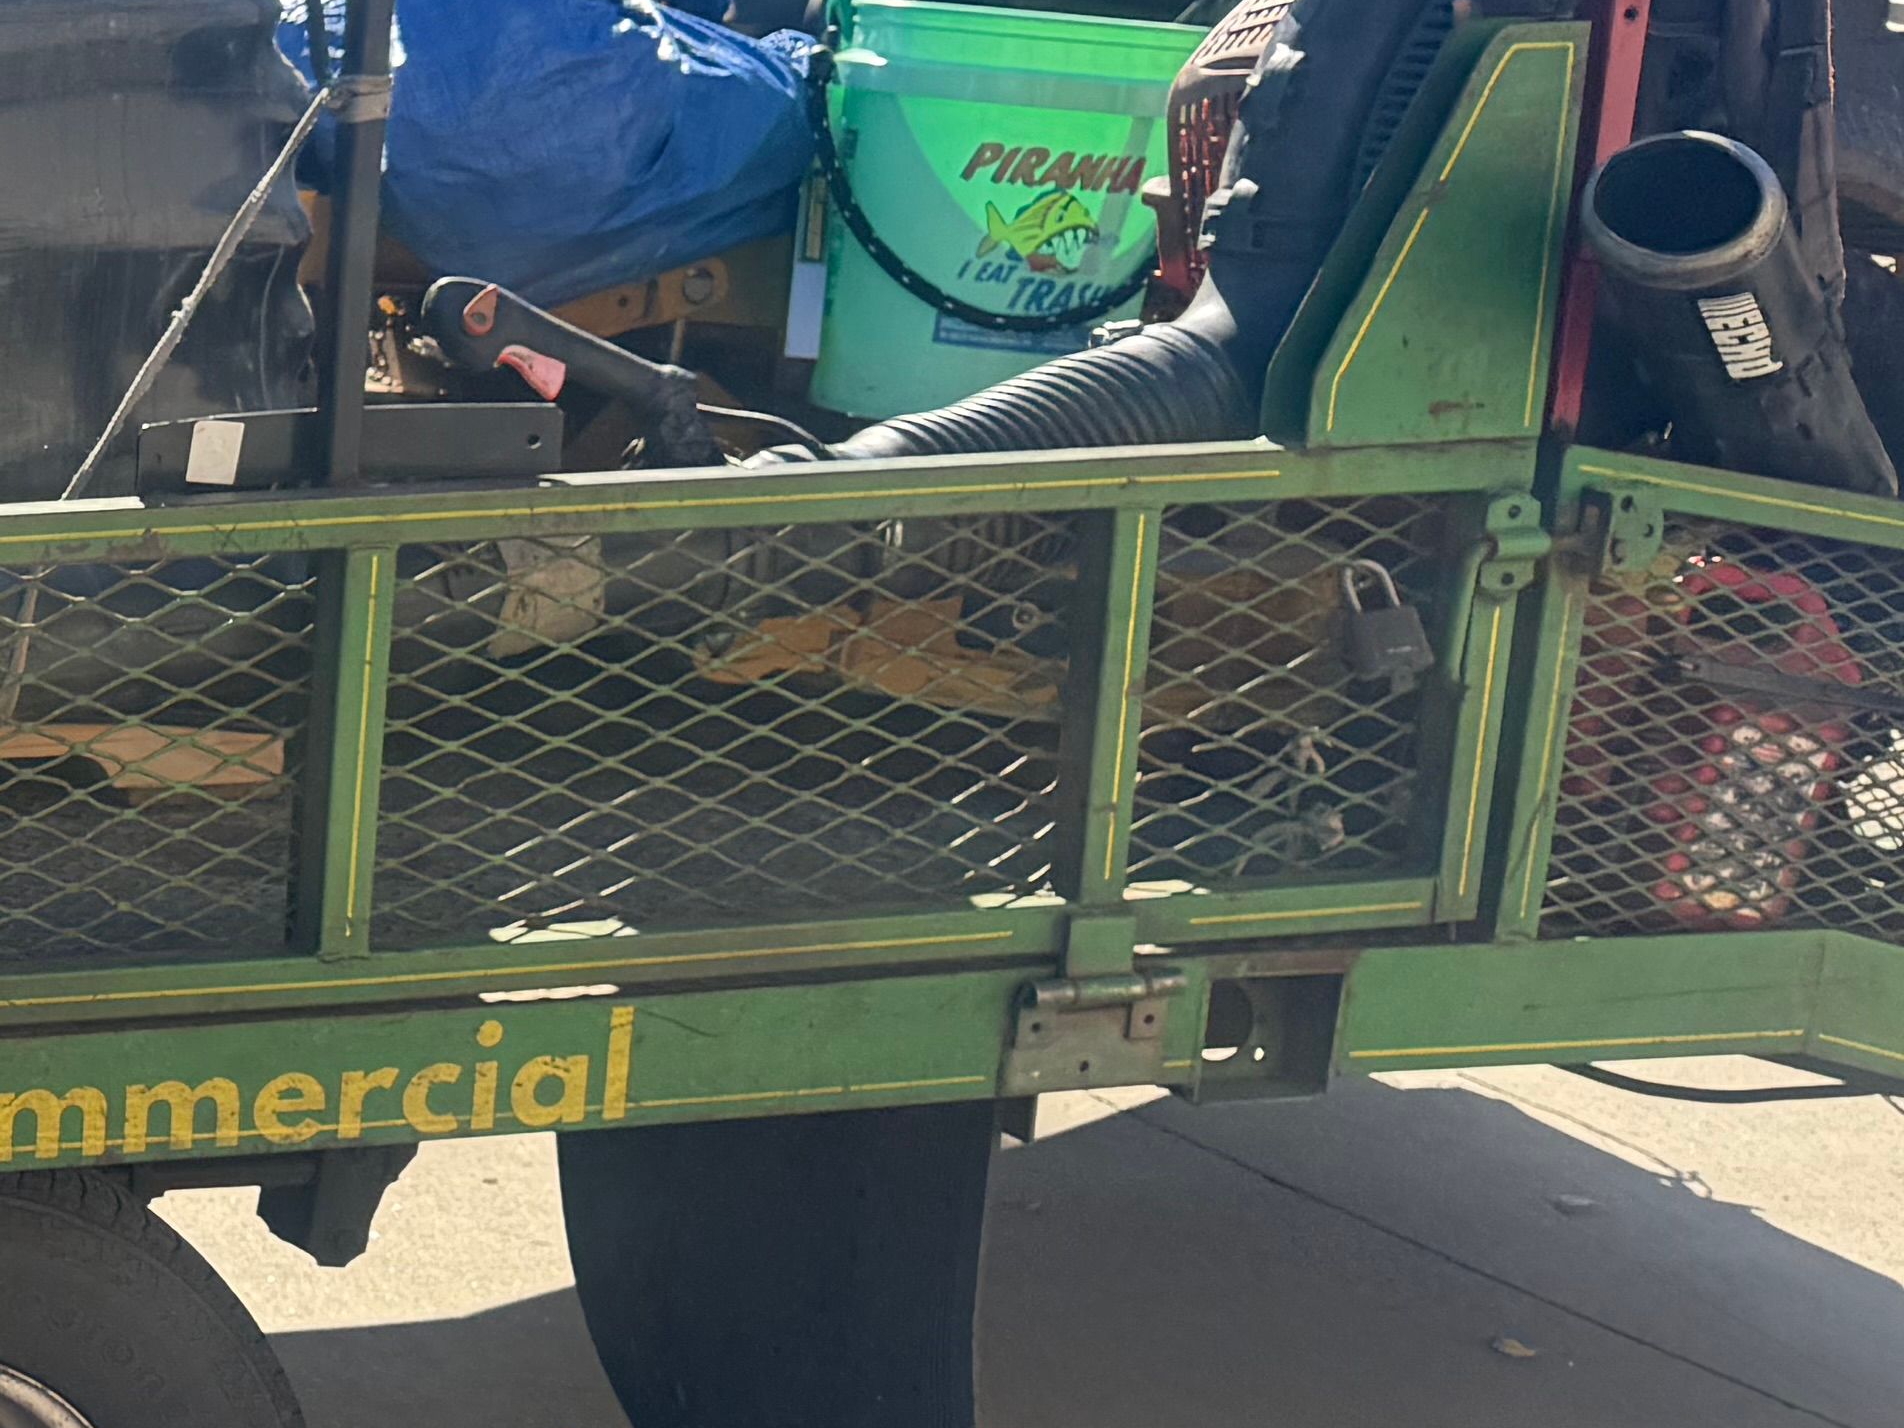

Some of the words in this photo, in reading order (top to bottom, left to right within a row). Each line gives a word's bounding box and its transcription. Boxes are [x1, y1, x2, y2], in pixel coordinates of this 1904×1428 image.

[959, 142, 1147, 196] PIRANHA
[956, 259, 972, 281] I
[975, 261, 1021, 284] EAT
